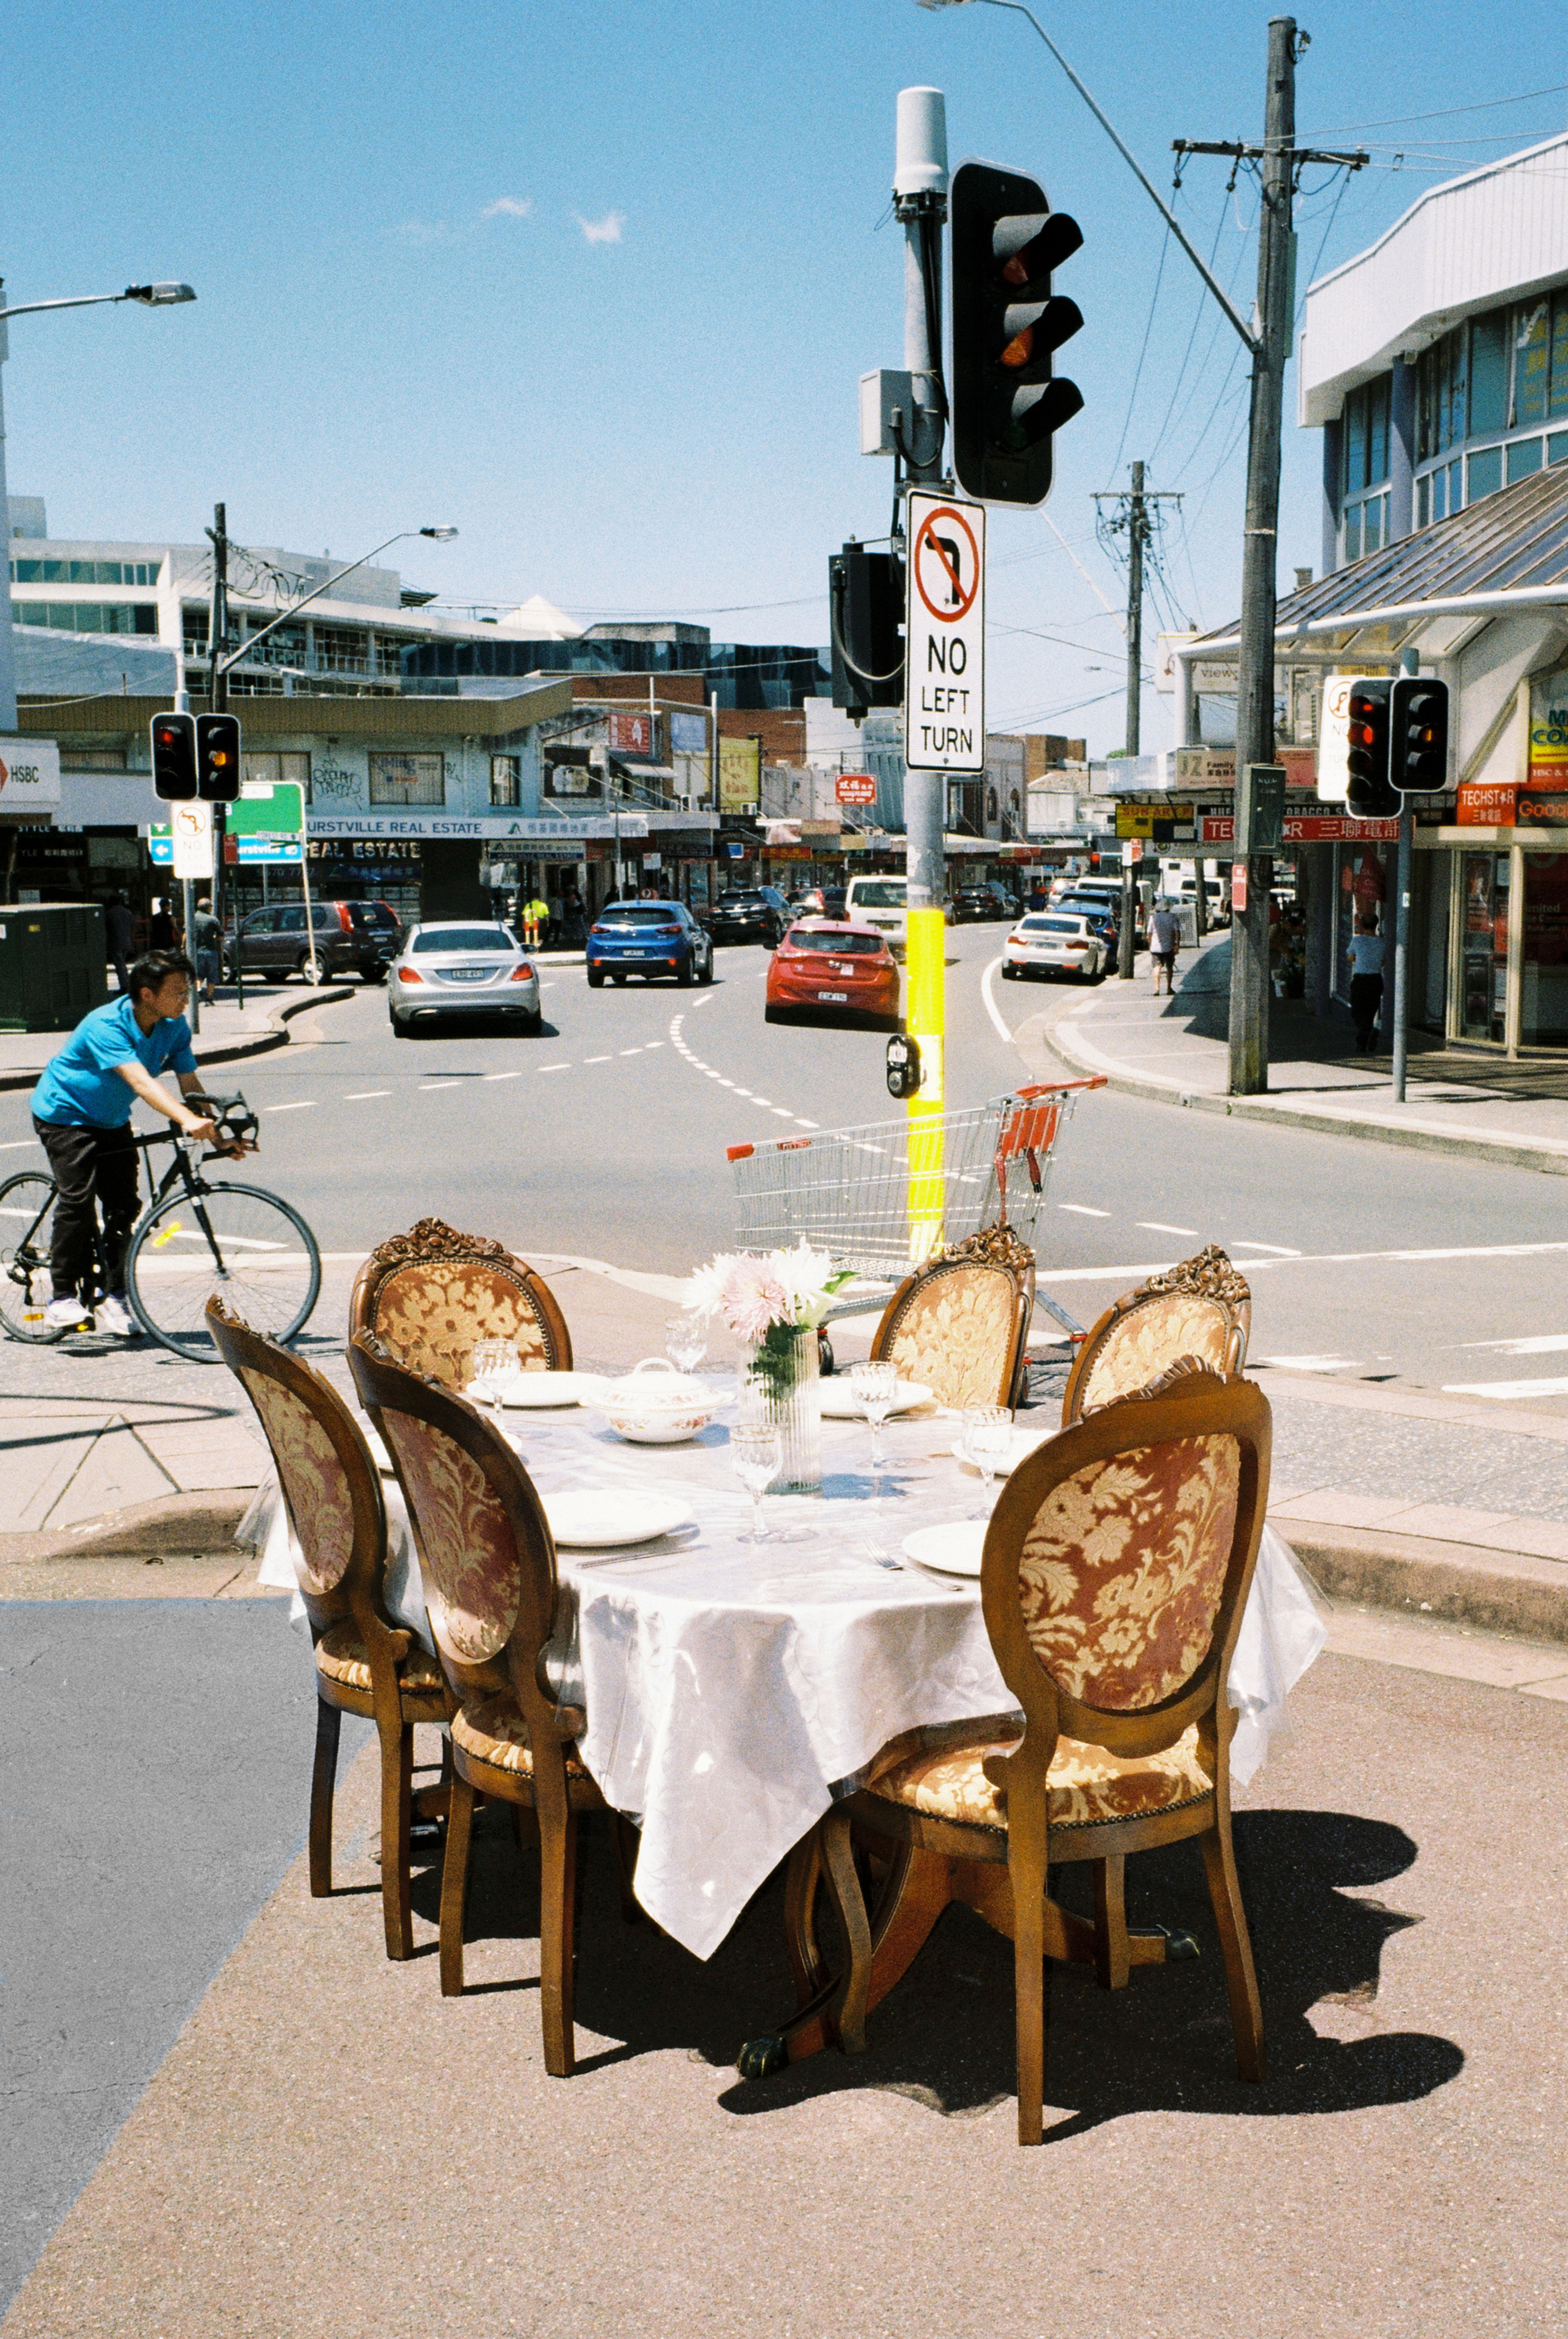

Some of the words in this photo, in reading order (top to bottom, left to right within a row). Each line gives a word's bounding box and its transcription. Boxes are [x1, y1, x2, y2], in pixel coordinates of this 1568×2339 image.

[928, 634, 967, 676] NO
[1201, 667, 1238, 680] view
[922, 686, 970, 714] LEFT
[1548, 709, 1568, 725] M
[920, 725, 972, 753] TURN
[1207, 761, 1234, 770] Family
[10, 766, 39, 783] HSBC
[1284, 807, 1330, 816] OBACCO
[307, 821, 385, 832] URSTVILLE
[390, 822, 427, 833] REAL
[432, 822, 482, 834] ESTATE
[183, 840, 202, 851] NO
[238, 843, 281, 854] urstville
[309, 841, 344, 858] EAL
[352, 842, 421, 859] ESTATE
